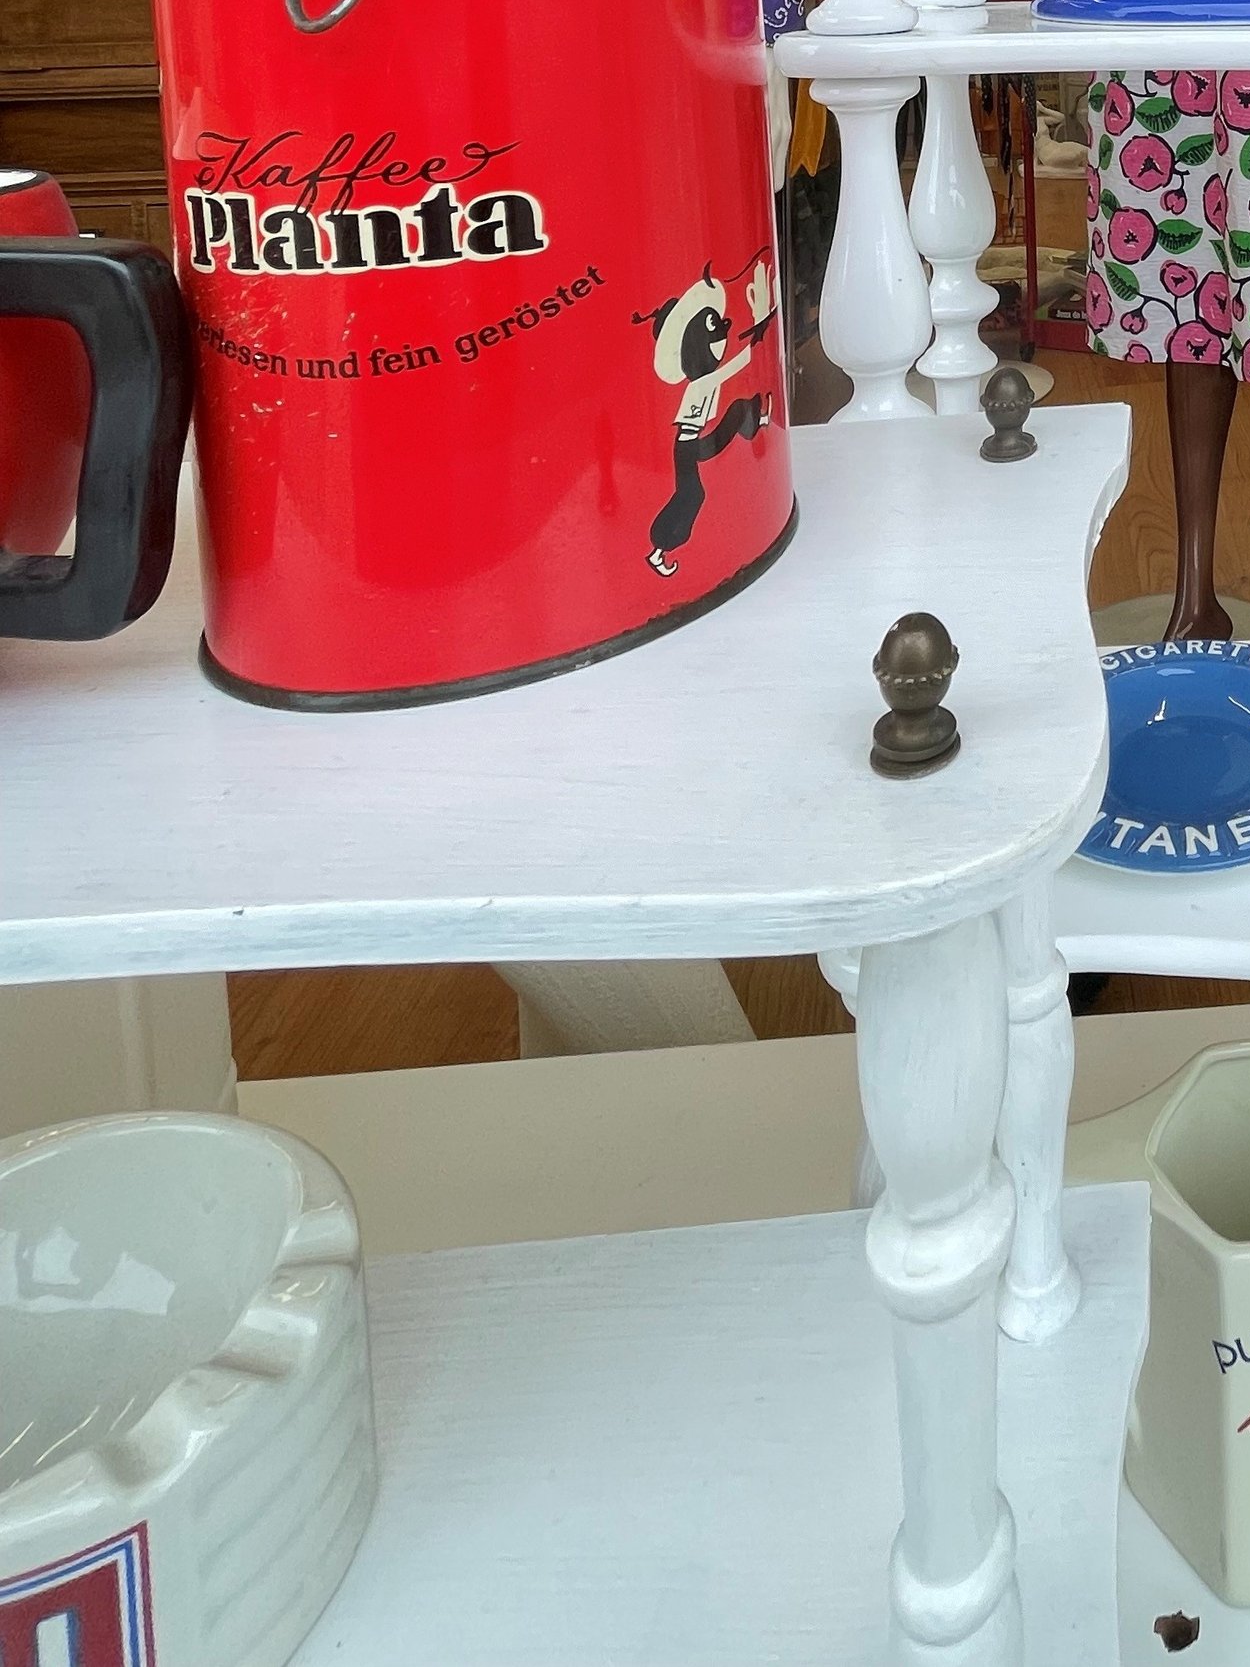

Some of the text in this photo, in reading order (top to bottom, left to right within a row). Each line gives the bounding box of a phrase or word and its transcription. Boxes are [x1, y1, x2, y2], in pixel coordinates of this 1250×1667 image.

[194, 131, 523, 215] Kaffee
[185, 186, 546, 272] Planta
[196, 264, 607, 380] erlesen und fein geröstet
